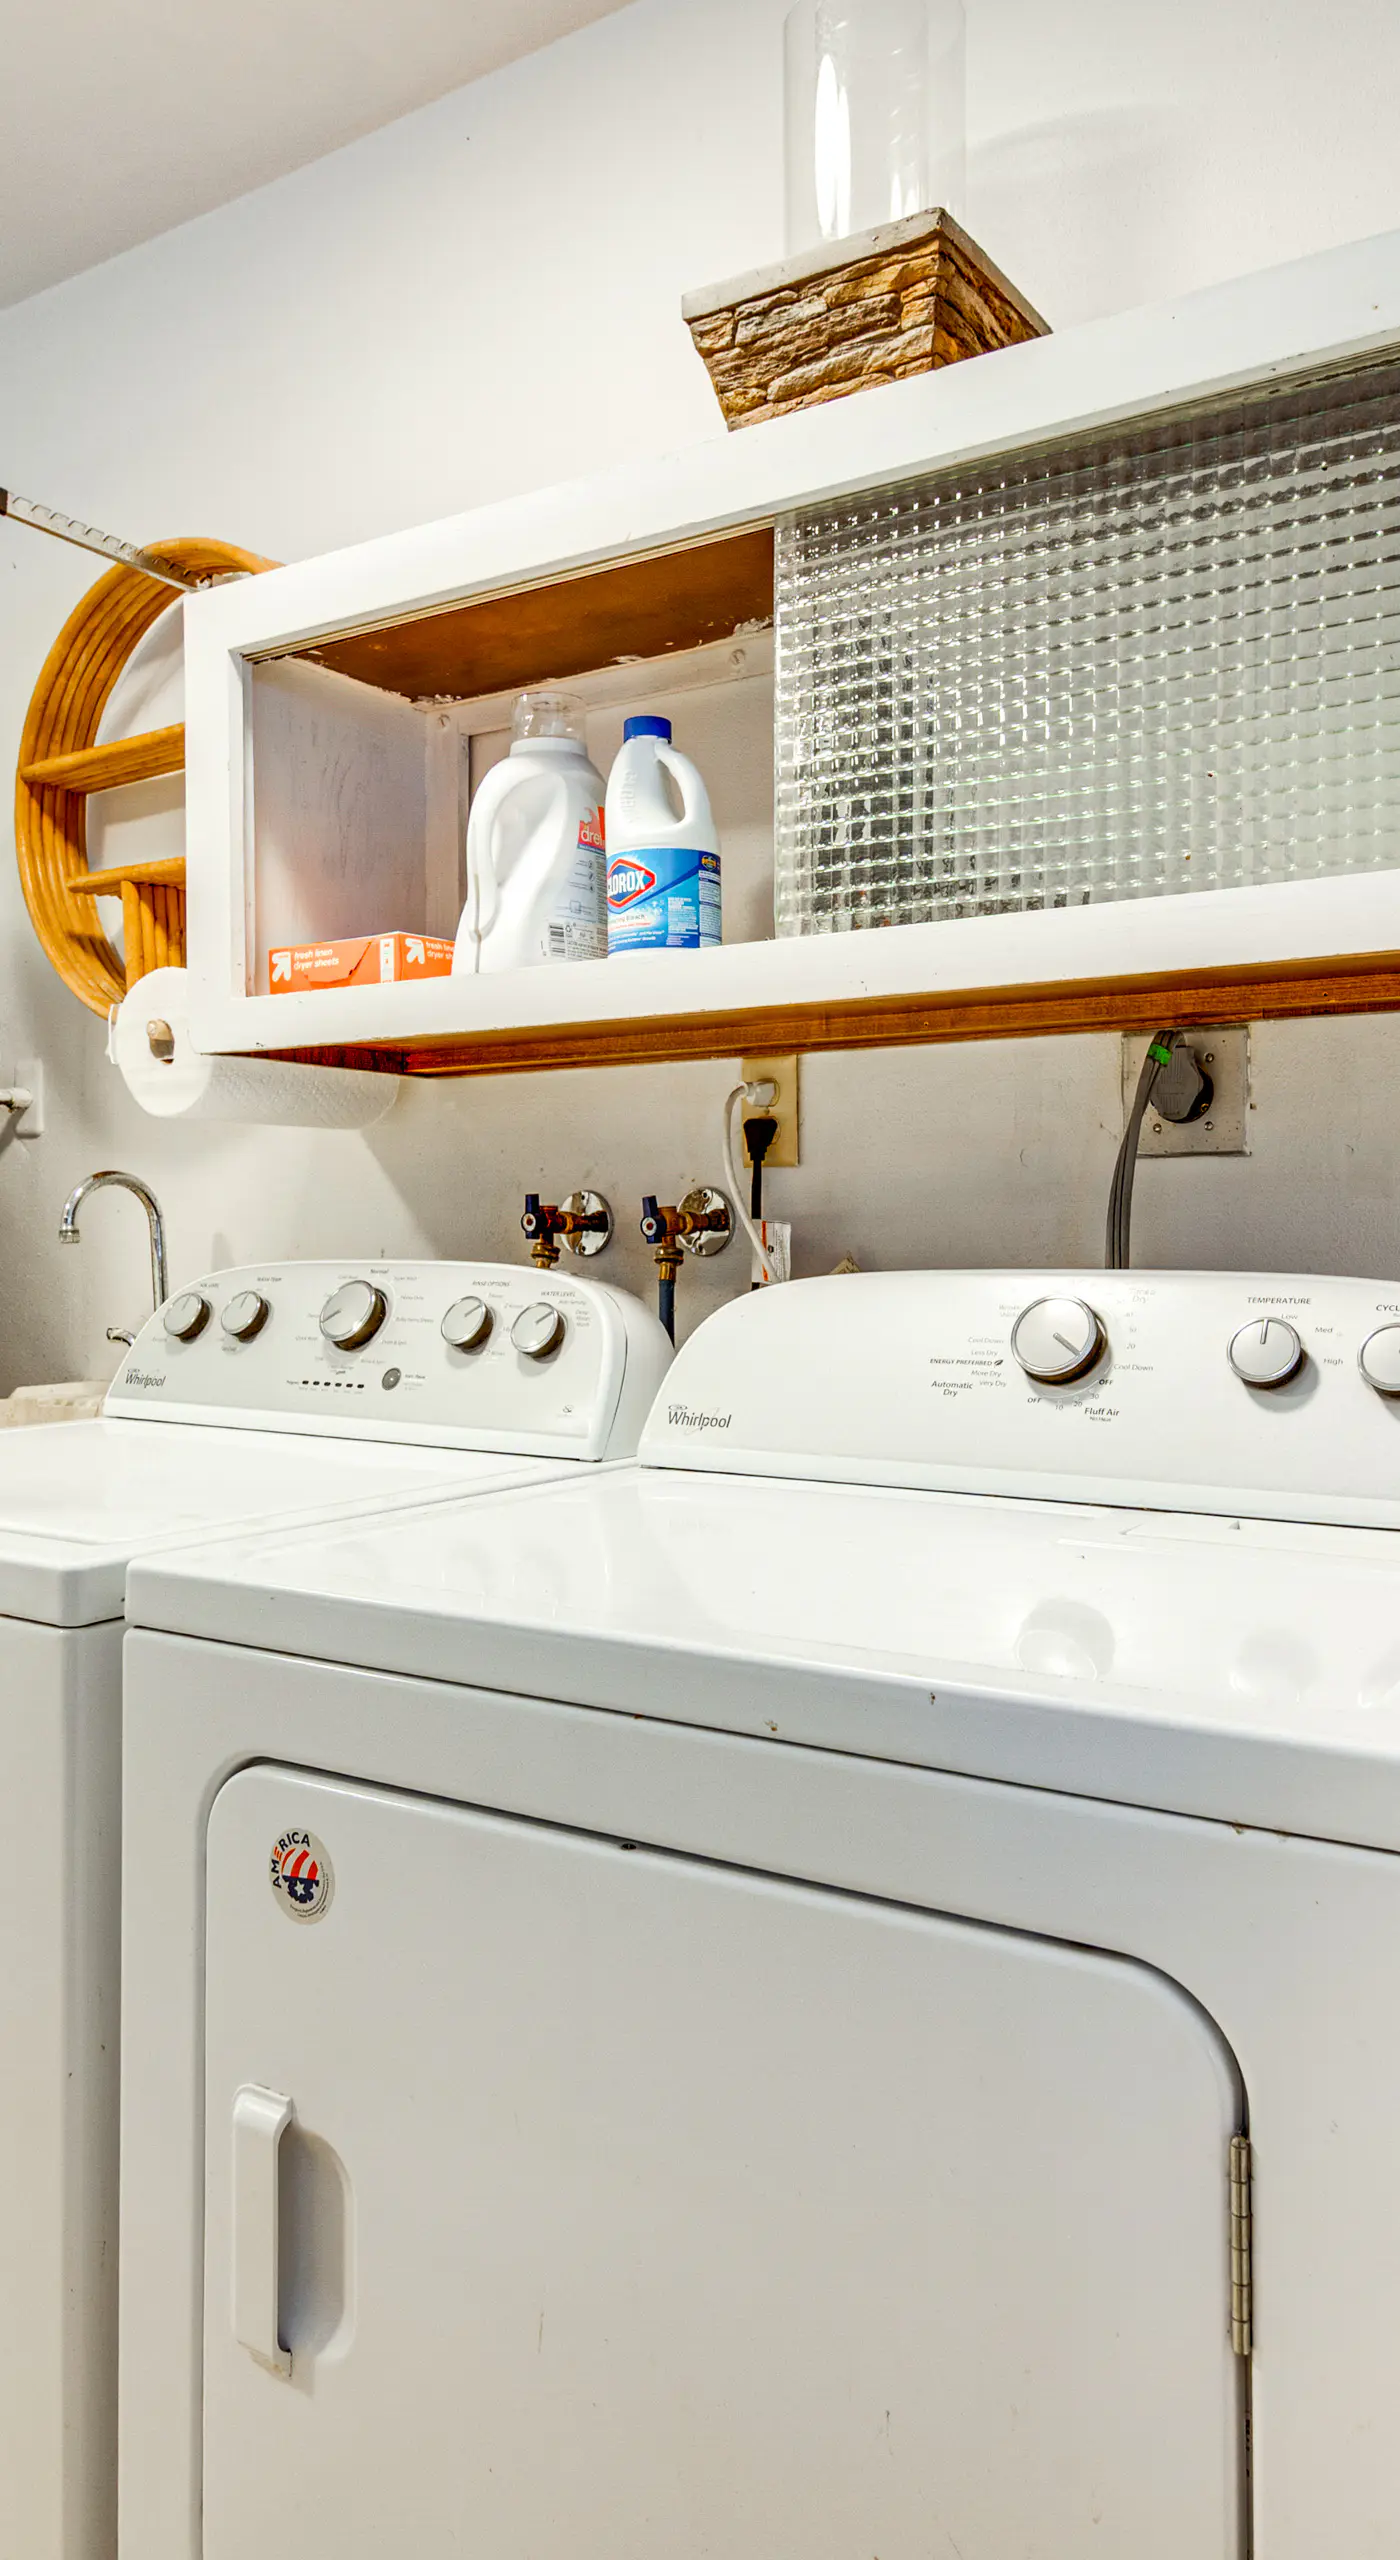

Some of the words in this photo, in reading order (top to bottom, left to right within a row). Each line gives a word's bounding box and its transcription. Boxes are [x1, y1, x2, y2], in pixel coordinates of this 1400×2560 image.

[294, 949, 313, 961] fresh
[315, 948, 333, 958] linen
[293, 961, 313, 971] dryer
[314, 957, 340, 968] sheets
[1247, 1297, 1312, 1305] TEMPERATURE
[1376, 1304, 1400, 1312] CYCL
[1314, 1326, 1334, 1334] Med
[1323, 1357, 1344, 1366] High
[1113, 1363, 1131, 1371] Cool
[1131, 1364, 1154, 1372] Down
[989, 1370, 1002, 1378] Dry
[125, 1372, 167, 1389] Whirlpool
[931, 1380, 973, 1389] Automatic
[994, 1380, 1007, 1388] Dry
[1098, 1378, 1113, 1386] OFF
[943, 1388, 958, 1397] Dry
[1073, 1400, 1083, 1408] 20
[1084, 1407, 1105, 1416] Fluff
[1106, 1408, 1120, 1416] Air
[668, 1410, 732, 1431] Whirlpool
[271, 1831, 311, 1889] AMERICA
